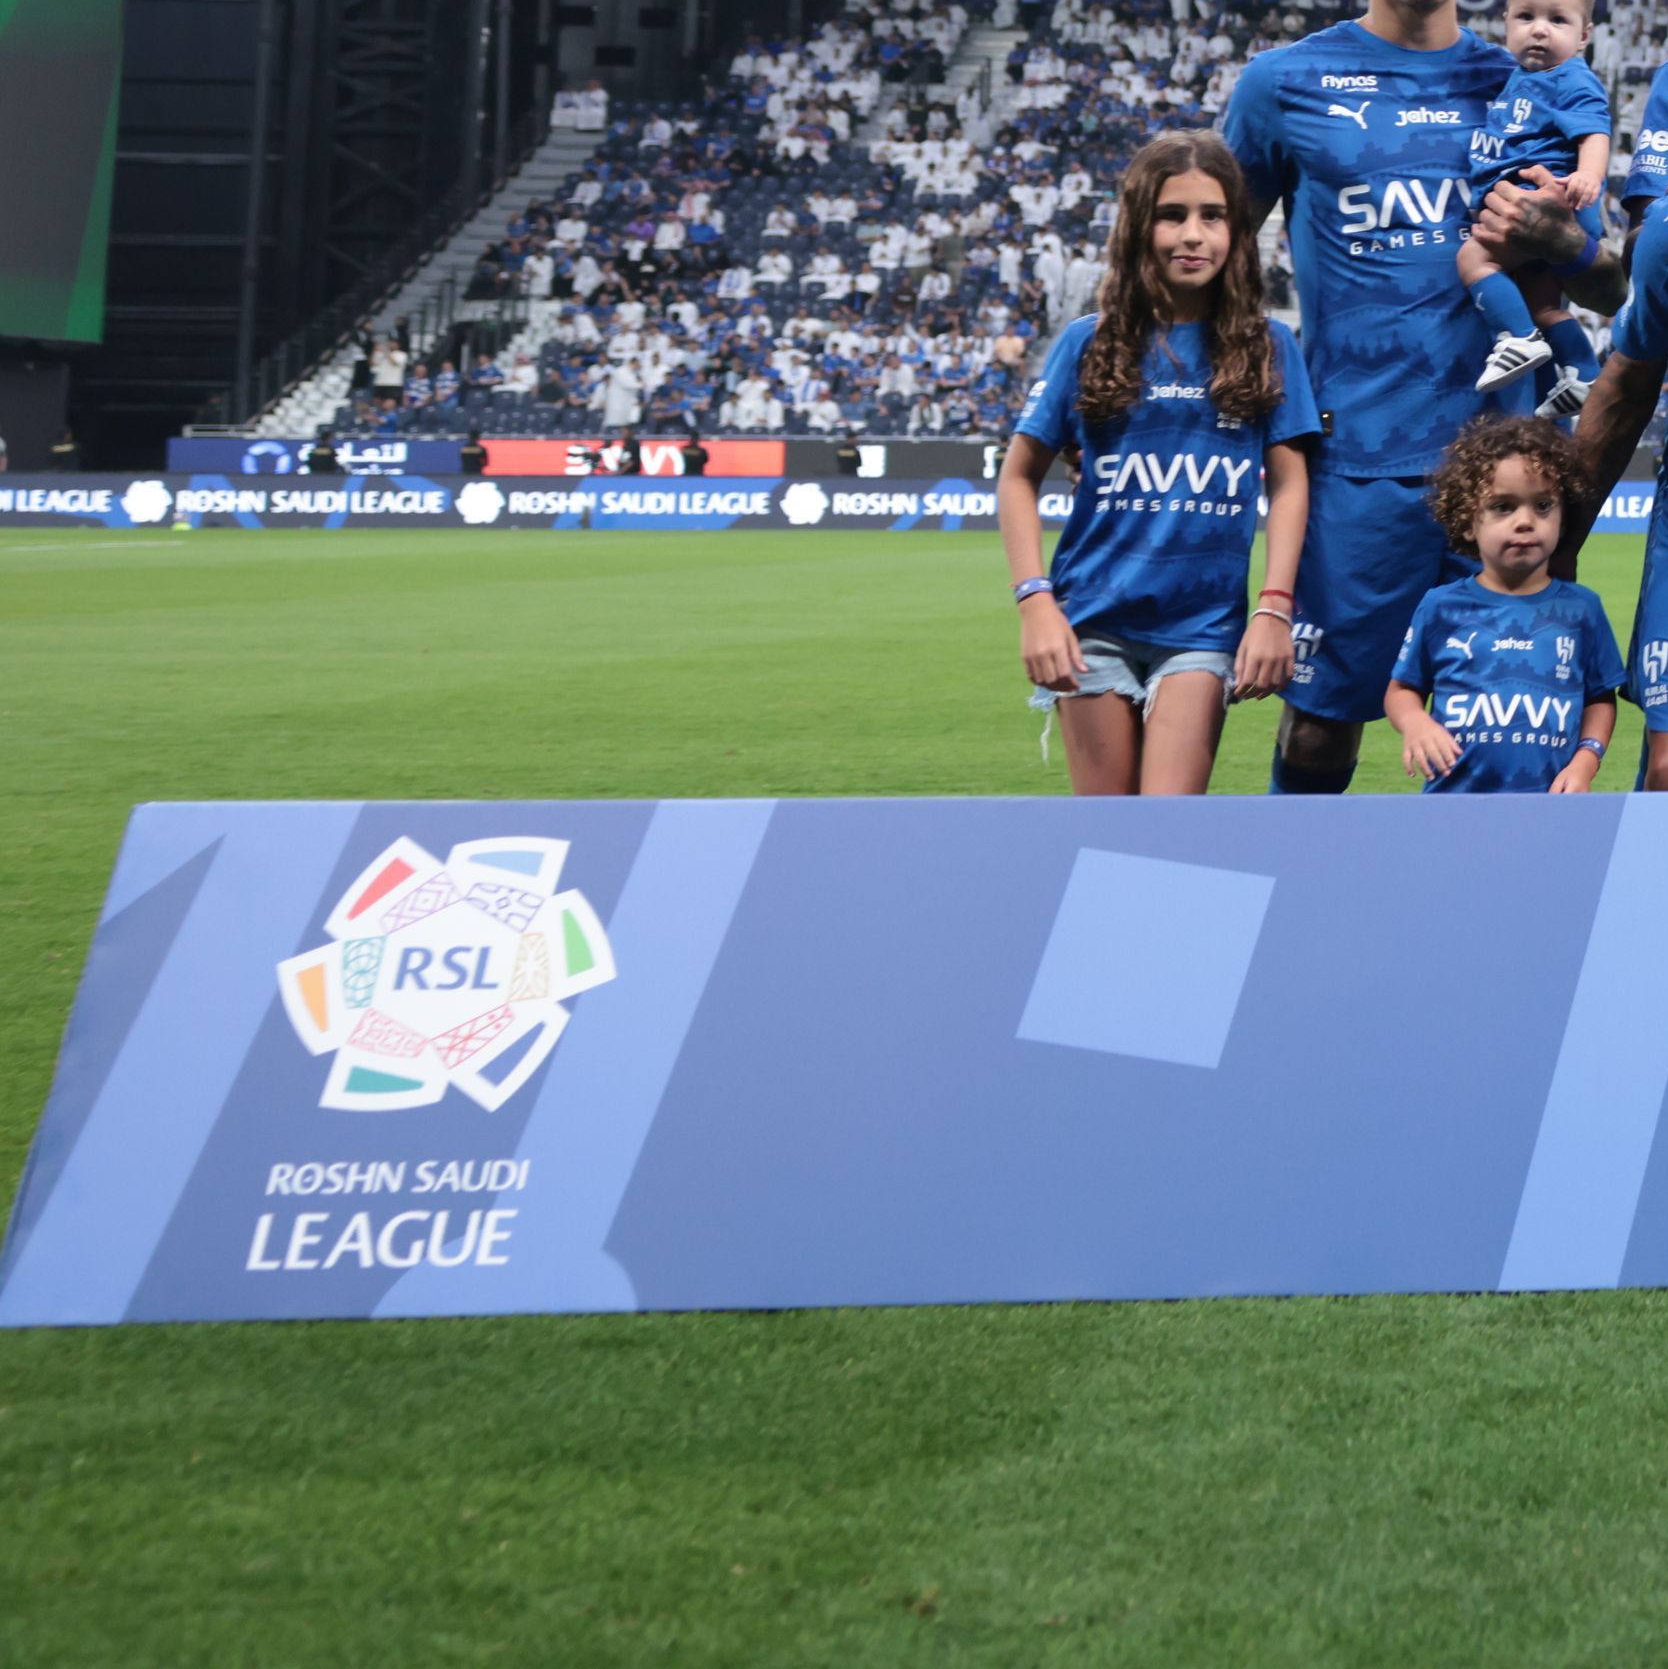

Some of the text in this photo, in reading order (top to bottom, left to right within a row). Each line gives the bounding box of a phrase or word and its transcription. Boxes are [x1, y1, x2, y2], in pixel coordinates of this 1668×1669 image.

[1321, 75, 1378, 89] flynas
[1338, 178, 1472, 234] SAV
[1349, 228, 1446, 256] GAMES
[1094, 452, 1252, 498] SAVVY
[16, 489, 113, 512] LEAGUE
[176, 490, 447, 514] ROSHN SAUDI LEAGUE
[508, 491, 772, 515] ROSHN SAUDI LEAGUE
[832, 492, 998, 516] ROSHN SAUDI
[1168, 499, 1243, 516] GROUP
[1444, 693, 1572, 732] SAVVY
[1453, 731, 1568, 748] AMES GROUP
[393, 946, 500, 992] RSL
[265, 1159, 531, 1196] ROSHN SAUDI
[245, 1208, 520, 1271] LEAGUE
